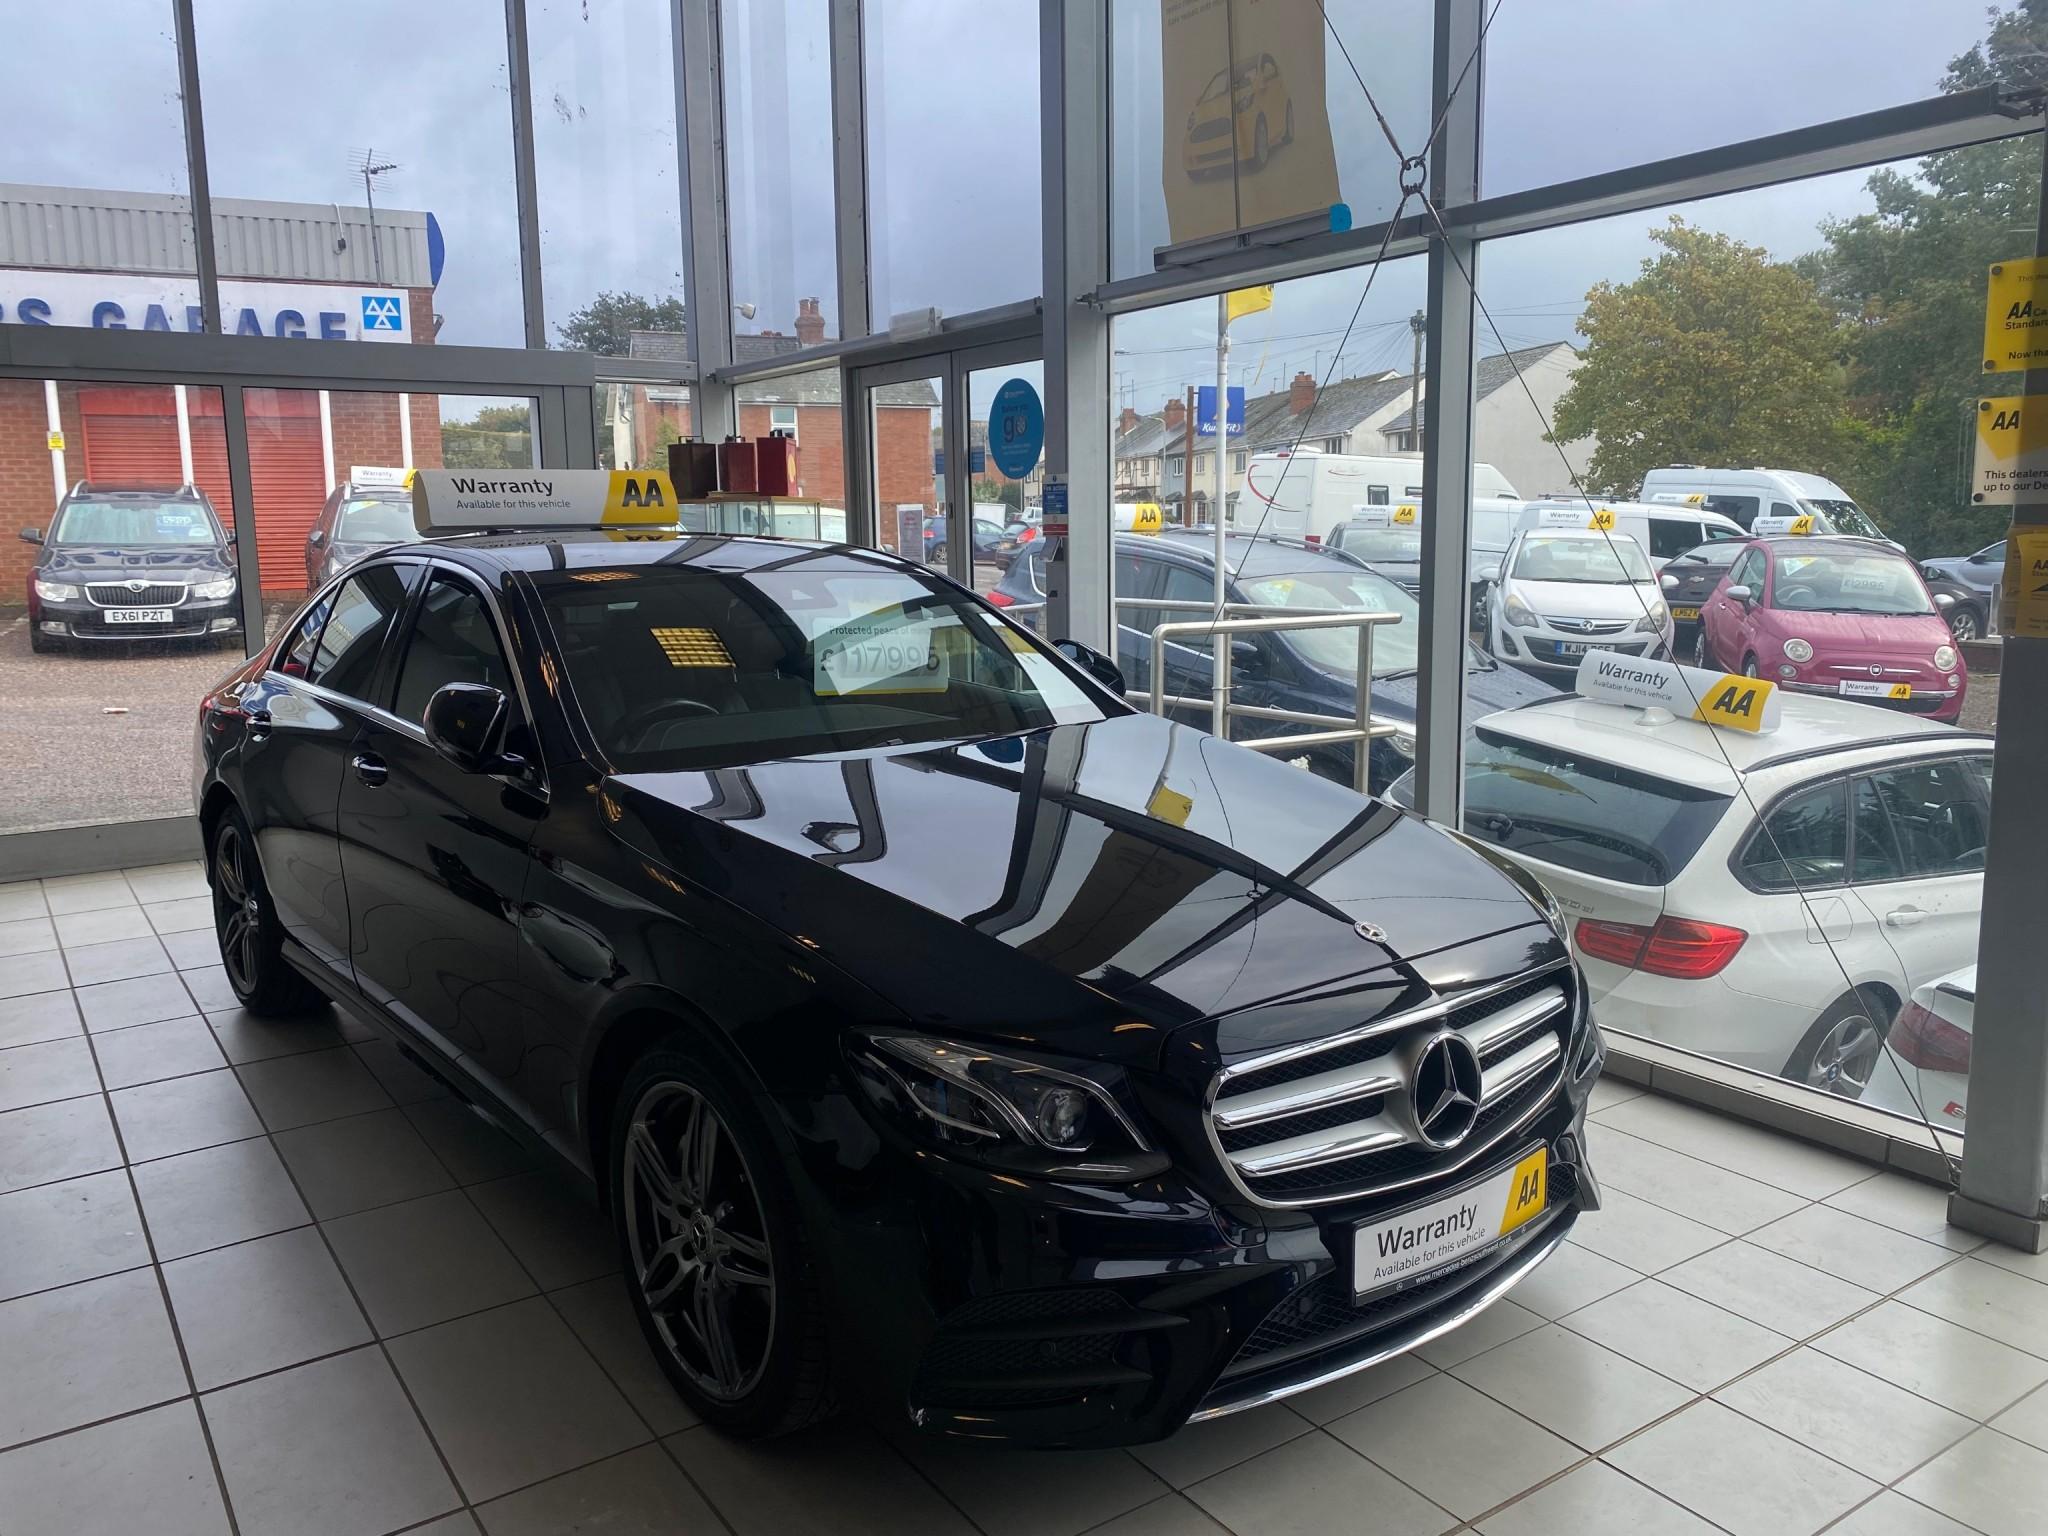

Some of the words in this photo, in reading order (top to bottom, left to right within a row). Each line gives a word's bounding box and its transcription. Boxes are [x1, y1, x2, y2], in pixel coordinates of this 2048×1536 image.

[2006, 300, 2032, 320] AA
[2009, 350, 2032, 360] Now
[1991, 410, 2020, 431] AA
[1985, 470, 2007, 480] This
[451, 477, 553, 497] Warranty
[622, 479, 664, 507] AA
[1984, 484, 1997, 493] up
[2000, 482, 2011, 491] to
[2013, 482, 2031, 491] our
[456, 499, 501, 509] Available
[503, 499, 516, 509] for
[518, 499, 536, 508] this
[537, 499, 571, 509] vehicle
[1140, 508, 1157, 523] AA
[1400, 508, 1412, 517] AA
[1550, 511, 1580, 520] Warranty
[1596, 514, 1611, 525] AA
[1760, 518, 1784, 526] Warranty
[1796, 519, 1809, 530] AA
[112, 611, 139, 621] EX61
[142, 611, 165, 621] PZT
[829, 624, 873, 635] Protected
[1593, 679, 1623, 692] Available
[1624, 684, 1634, 694] for
[1634, 685, 1647, 697] this
[1648, 689, 1673, 701] vehicle
[1597, 661, 1669, 690] Warranty
[1713, 686, 1757, 717] AA
[1846, 683, 1880, 693] Warranty
[1895, 687, 1907, 697] AA
[1377, 1203, 1478, 1258] Warranty
[1516, 1168, 1539, 1211] AA
[1374, 1256, 1421, 1280] Available
[1423, 1249, 1437, 1262] for
[1438, 1241, 1455, 1257] this
[1456, 1227, 1486, 1248] vehicle
